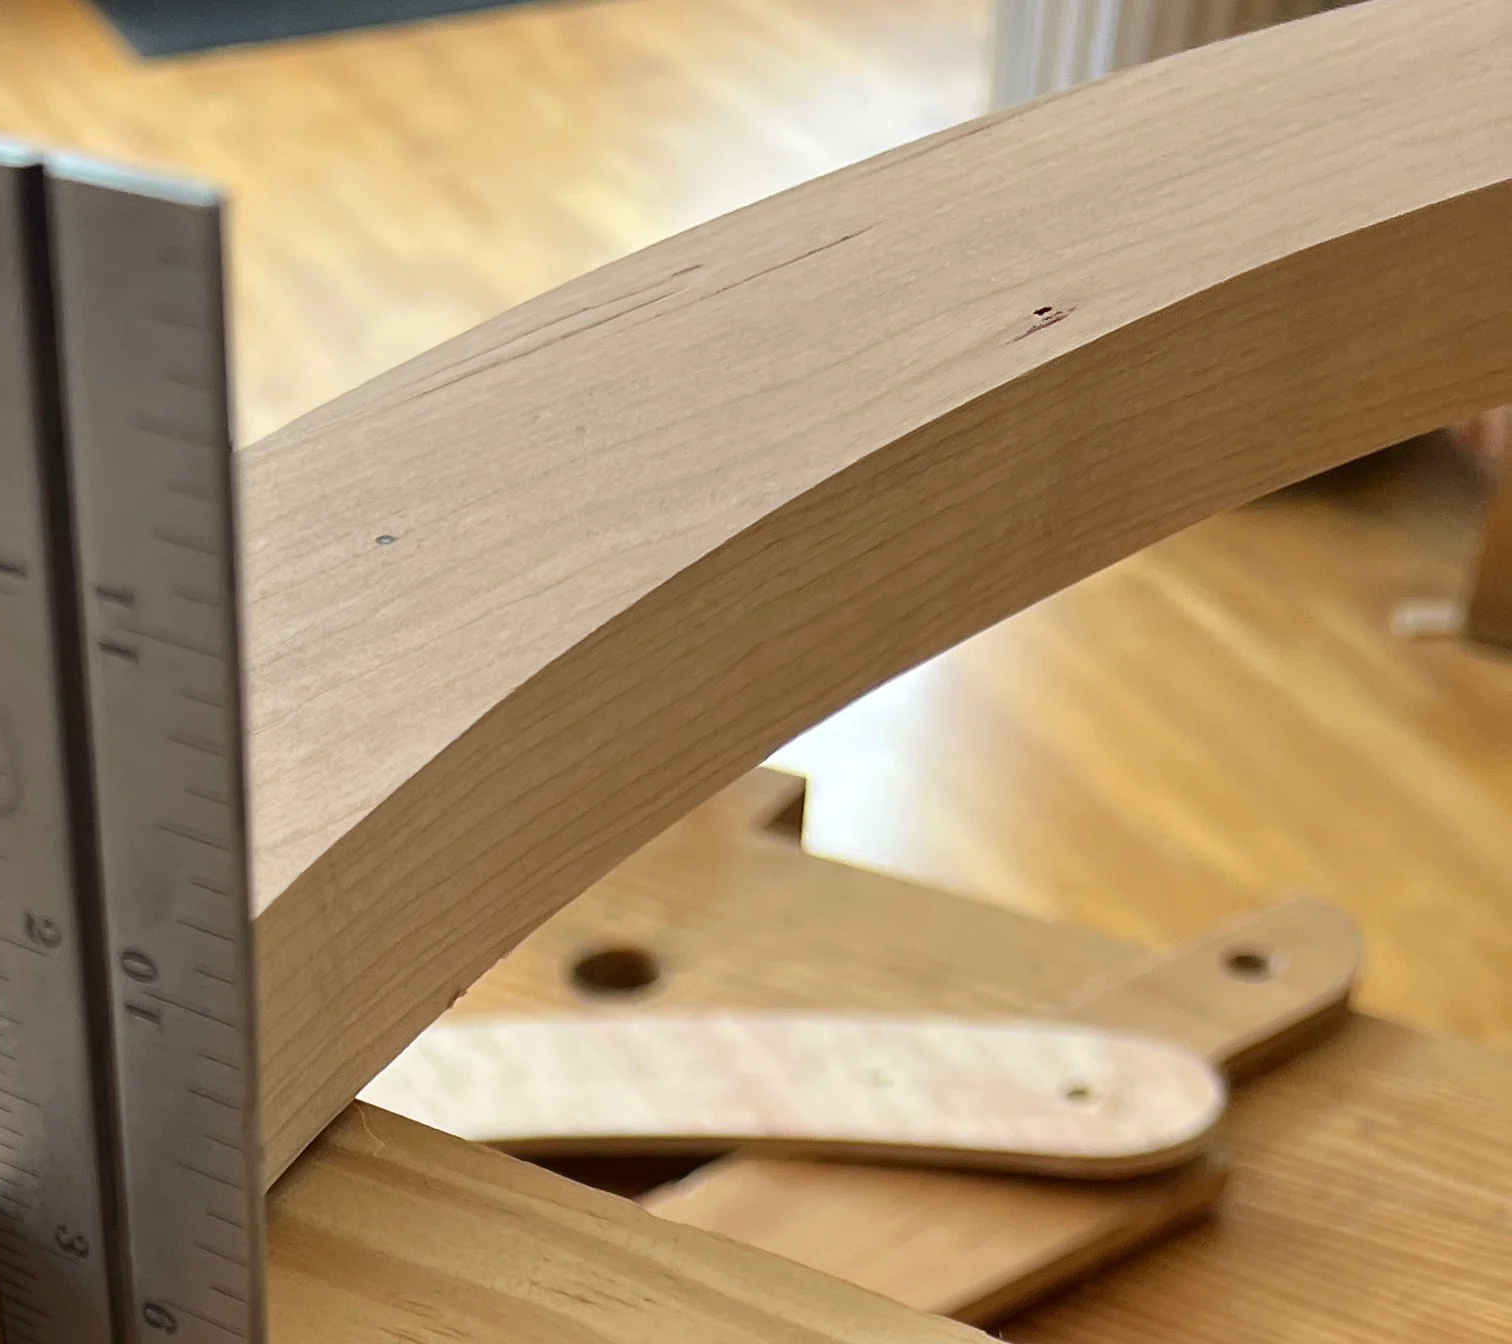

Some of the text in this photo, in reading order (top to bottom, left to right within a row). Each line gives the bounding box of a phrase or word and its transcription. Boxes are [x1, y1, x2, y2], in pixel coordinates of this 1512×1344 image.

[23, 911, 62, 949] 2
[120, 949, 163, 1026] 10
[56, 1225, 88, 1259] 3
